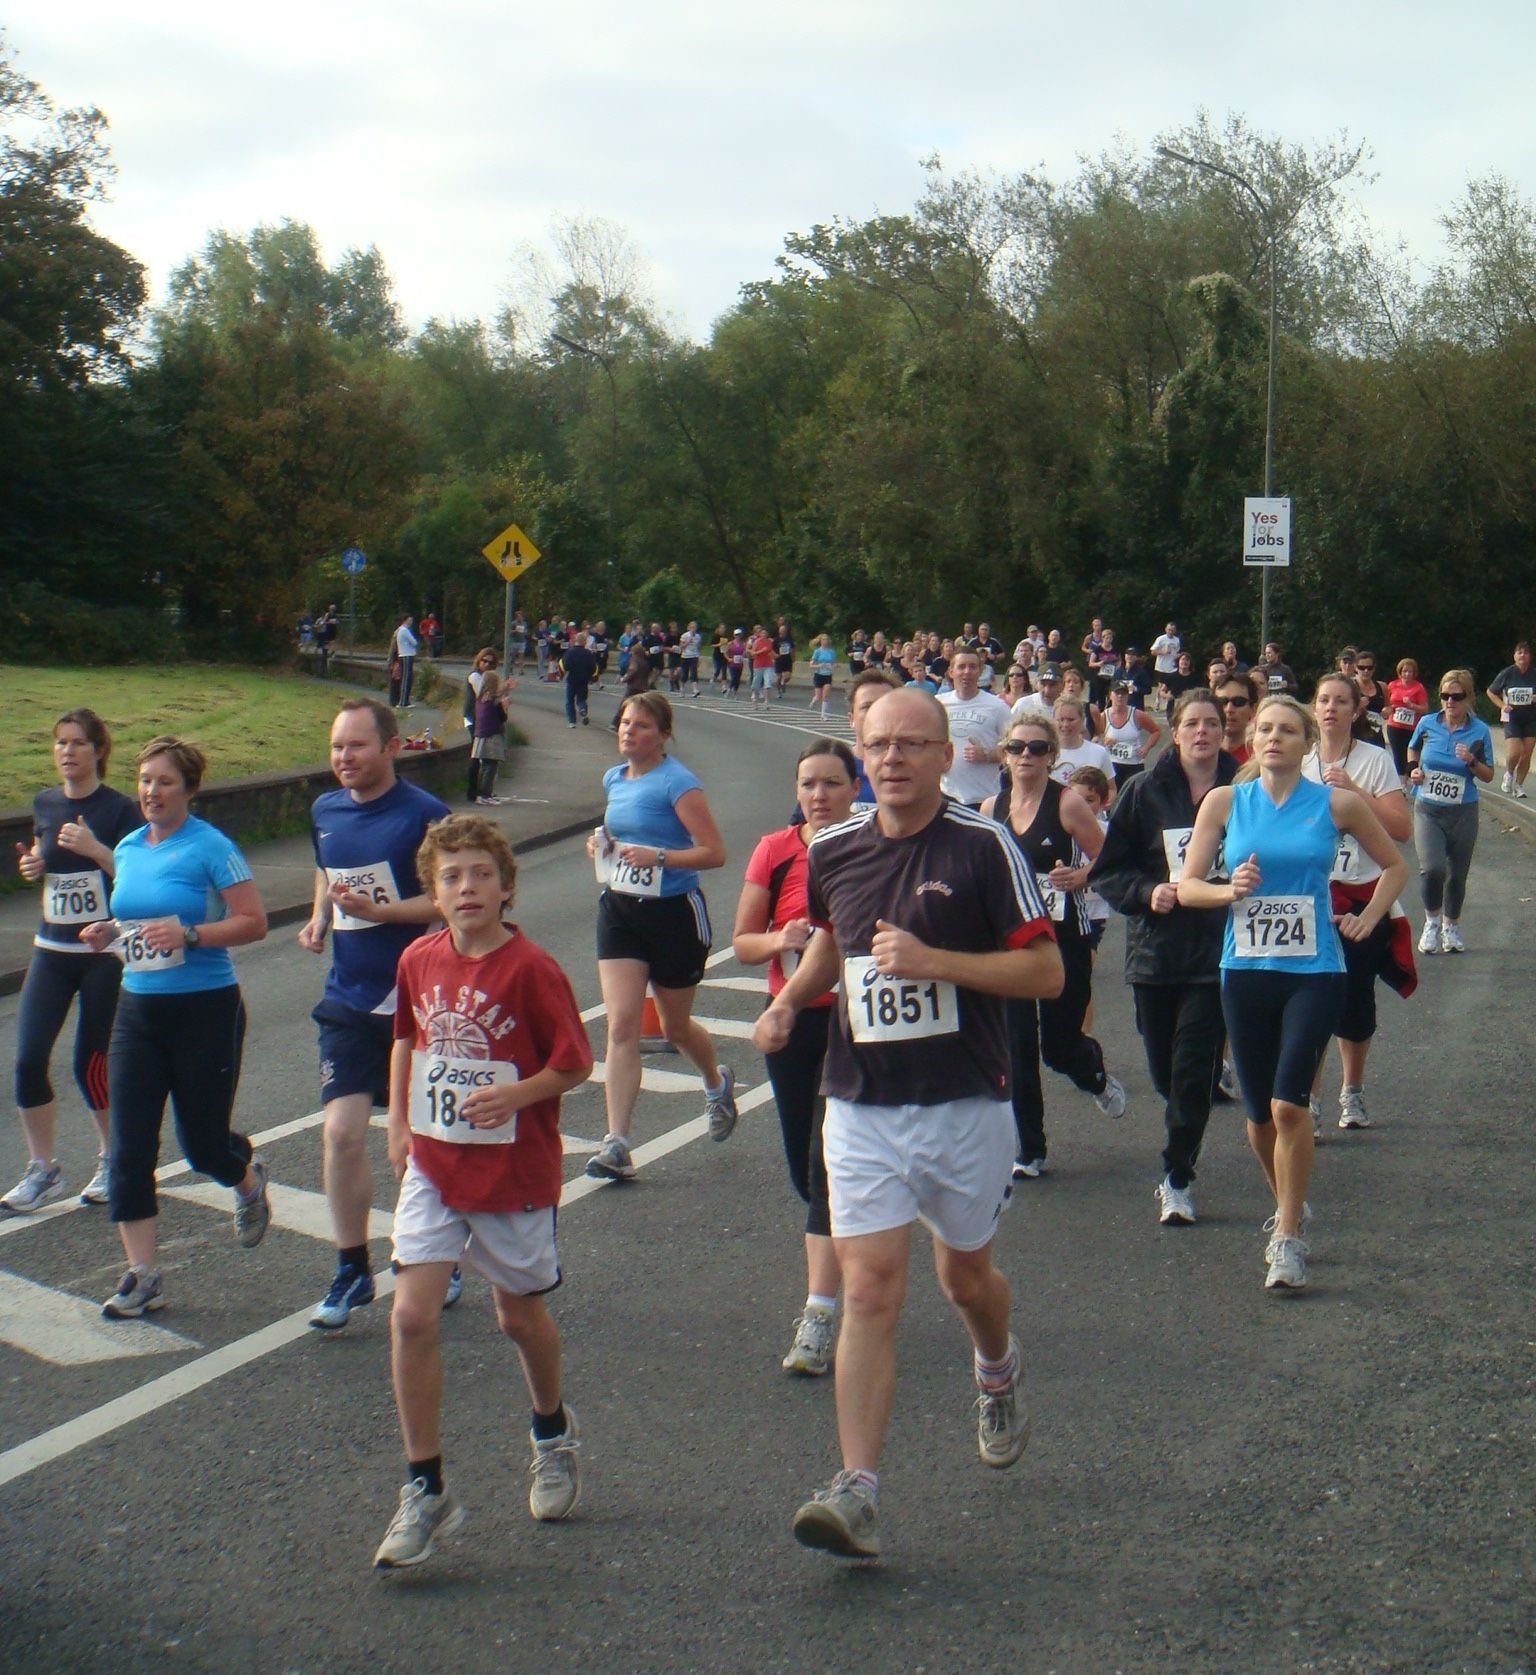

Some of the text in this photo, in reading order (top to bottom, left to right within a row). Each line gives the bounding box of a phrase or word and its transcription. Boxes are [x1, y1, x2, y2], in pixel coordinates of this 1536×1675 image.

[1251, 511, 1278, 524] Yes
[1251, 533, 1285, 548] jobs
[1429, 780, 1459, 799] 1603
[345, 873, 375, 887] asics
[614, 860, 654, 887] 1783
[60, 877, 89, 890] asics
[52, 890, 98, 915] 1708
[1263, 903, 1299, 915] asics
[1246, 917, 1306, 946] 1724
[455, 985, 517, 1041] STAR
[861, 982, 940, 1027] 1851
[447, 1067, 496, 1086] asics
